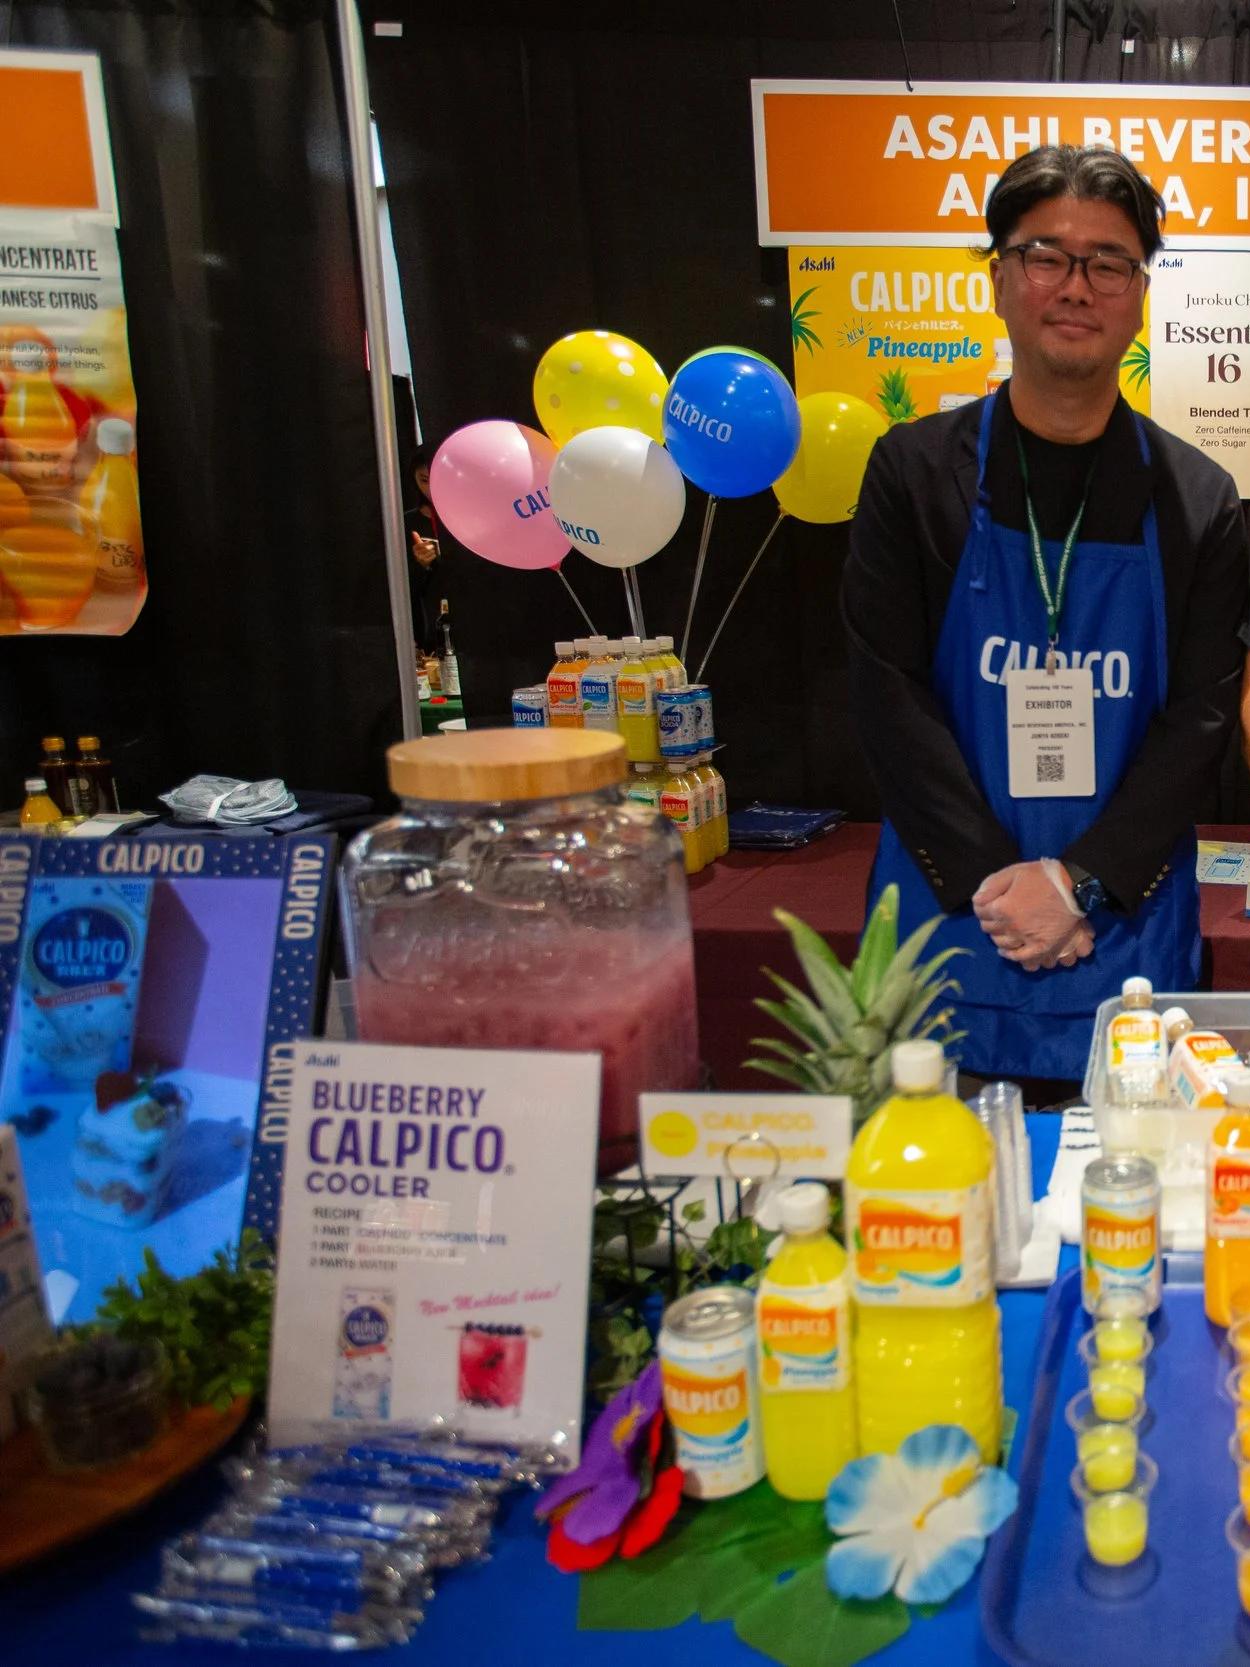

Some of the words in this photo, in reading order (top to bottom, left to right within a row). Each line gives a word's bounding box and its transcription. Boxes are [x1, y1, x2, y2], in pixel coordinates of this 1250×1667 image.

[883, 115, 1059, 160] ASAHI
[799, 257, 835, 272] Asahi
[1158, 258, 1183, 268] Asahi
[0, 289, 46, 309] ANESE
[48, 291, 98, 310] CITRUS
[850, 271, 992, 313] CALPICO
[1185, 294, 1233, 309] Juroku
[846, 325, 866, 344] NEW
[867, 335, 983, 364] Pineapple
[1207, 353, 1241, 384] 16
[667, 392, 732, 444] CALPICO
[1190, 407, 1240, 419] Blended
[1195, 426, 1215, 434] Zero
[1200, 439, 1220, 448] Zero
[1222, 439, 1247, 449] Sugar
[550, 685, 574, 693] CALPICO
[582, 684, 606, 694] CALPICO
[619, 685, 642, 693] CALPICO
[1025, 700, 1073, 710] EXHIBITOR
[514, 712, 541, 723] CALPICO
[662, 803, 686, 811] CALPICO
[98, 843, 205, 873] CALPICO
[282, 845, 325, 940] CALPICO
[40, 938, 126, 965] CALPICO
[259, 1042, 295, 1144] CALPICO
[311, 1079, 486, 1118] BLUEBERRY
[702, 1110, 817, 1132] CALPICO
[306, 1170, 429, 1199] COOLER
[323, 1224, 351, 1236] PART
[865, 1224, 955, 1252] CALPICO
[1088, 1228, 1150, 1250] CALPICO
[320, 1241, 351, 1253] PART
[359, 1259, 399, 1272] WATER
[762, 1317, 830, 1336] CALPICO
[666, 1385, 741, 1414] CALPICO
